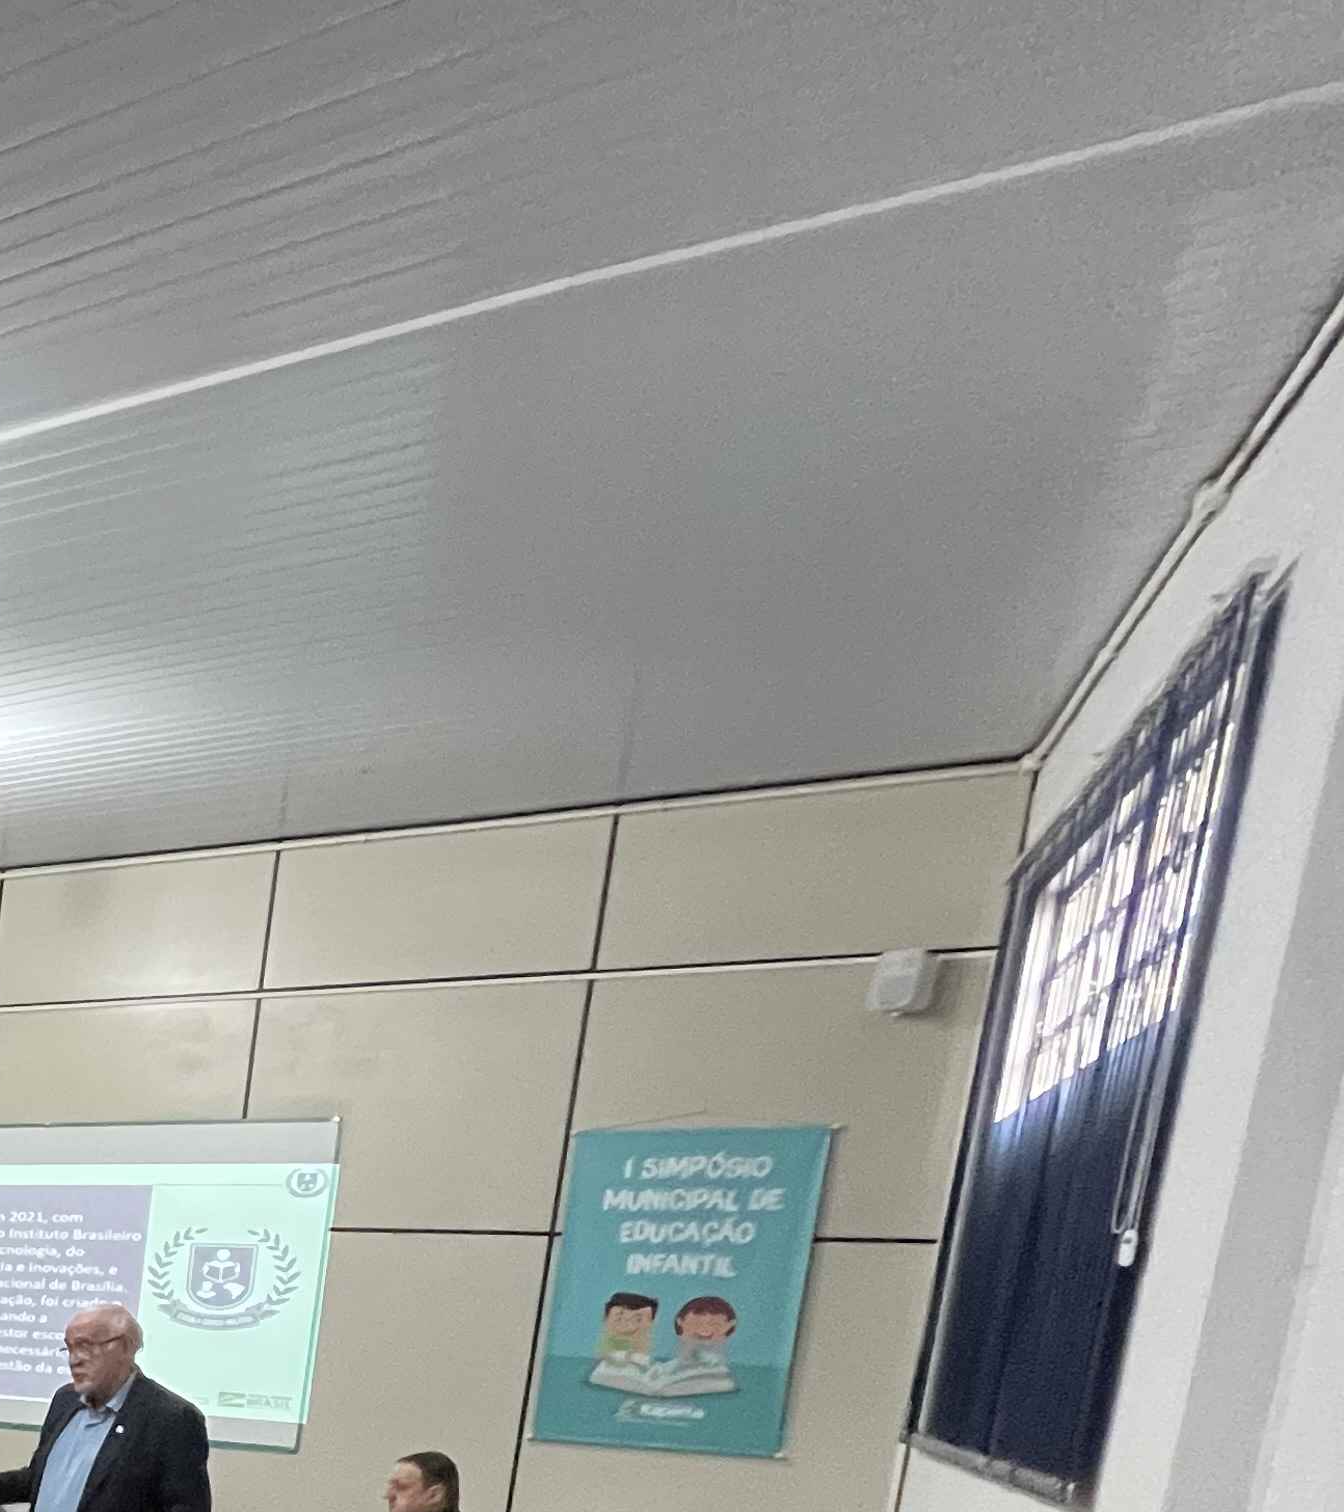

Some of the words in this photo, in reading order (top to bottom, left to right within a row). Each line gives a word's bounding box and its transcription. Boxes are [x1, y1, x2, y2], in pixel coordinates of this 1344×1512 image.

[624, 1155, 635, 1178] I
[641, 1152, 773, 1179] SIMPÓSIO
[602, 1188, 739, 1211] MUNICIPAL
[748, 1188, 787, 1211] DE
[9, 1211, 49, 1225] 2021,
[51, 1212, 85, 1224] com
[9, 1227, 69, 1240] Instituto
[73, 1229, 142, 1242] Brasileiro
[620, 1215, 756, 1247] EDUCAÇÃO
[65, 1245, 86, 1257] do
[16, 1263, 25, 1273] e
[108, 1265, 119, 1276] e
[626, 1253, 738, 1278] INFANTIL
[48, 1278, 67, 1291] de
[40, 1294, 60, 1307] foi
[39, 1314, 48, 1324] a
[32, 1331, 66, 1341] esco
[34, 1362, 53, 1374] da
